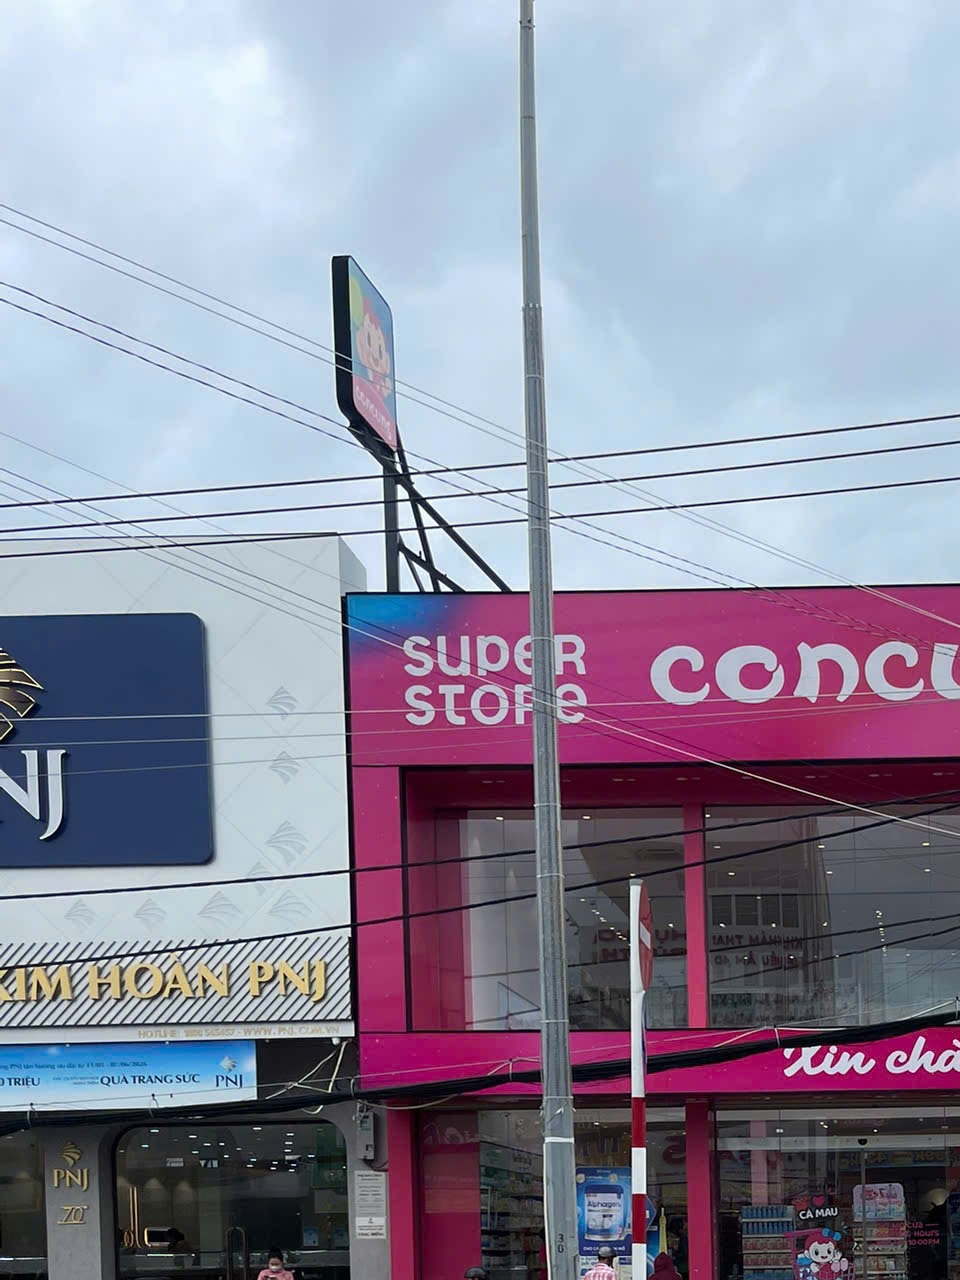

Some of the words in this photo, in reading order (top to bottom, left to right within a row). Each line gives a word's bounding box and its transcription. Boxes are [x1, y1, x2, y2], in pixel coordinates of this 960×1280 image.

[88, 953, 231, 999] HOÀN
[248, 959, 327, 1003] PNJ
[783, 1044, 876, 1077] Xin
[7, 1075, 41, 1088] TRIỆU
[131, 1073, 174, 1085] TRANG
[175, 1071, 201, 1084] SỨC
[216, 1074, 243, 1088] PNJ
[53, 1168, 88, 1191] PNJ
[815, 1207, 839, 1218] MAU
